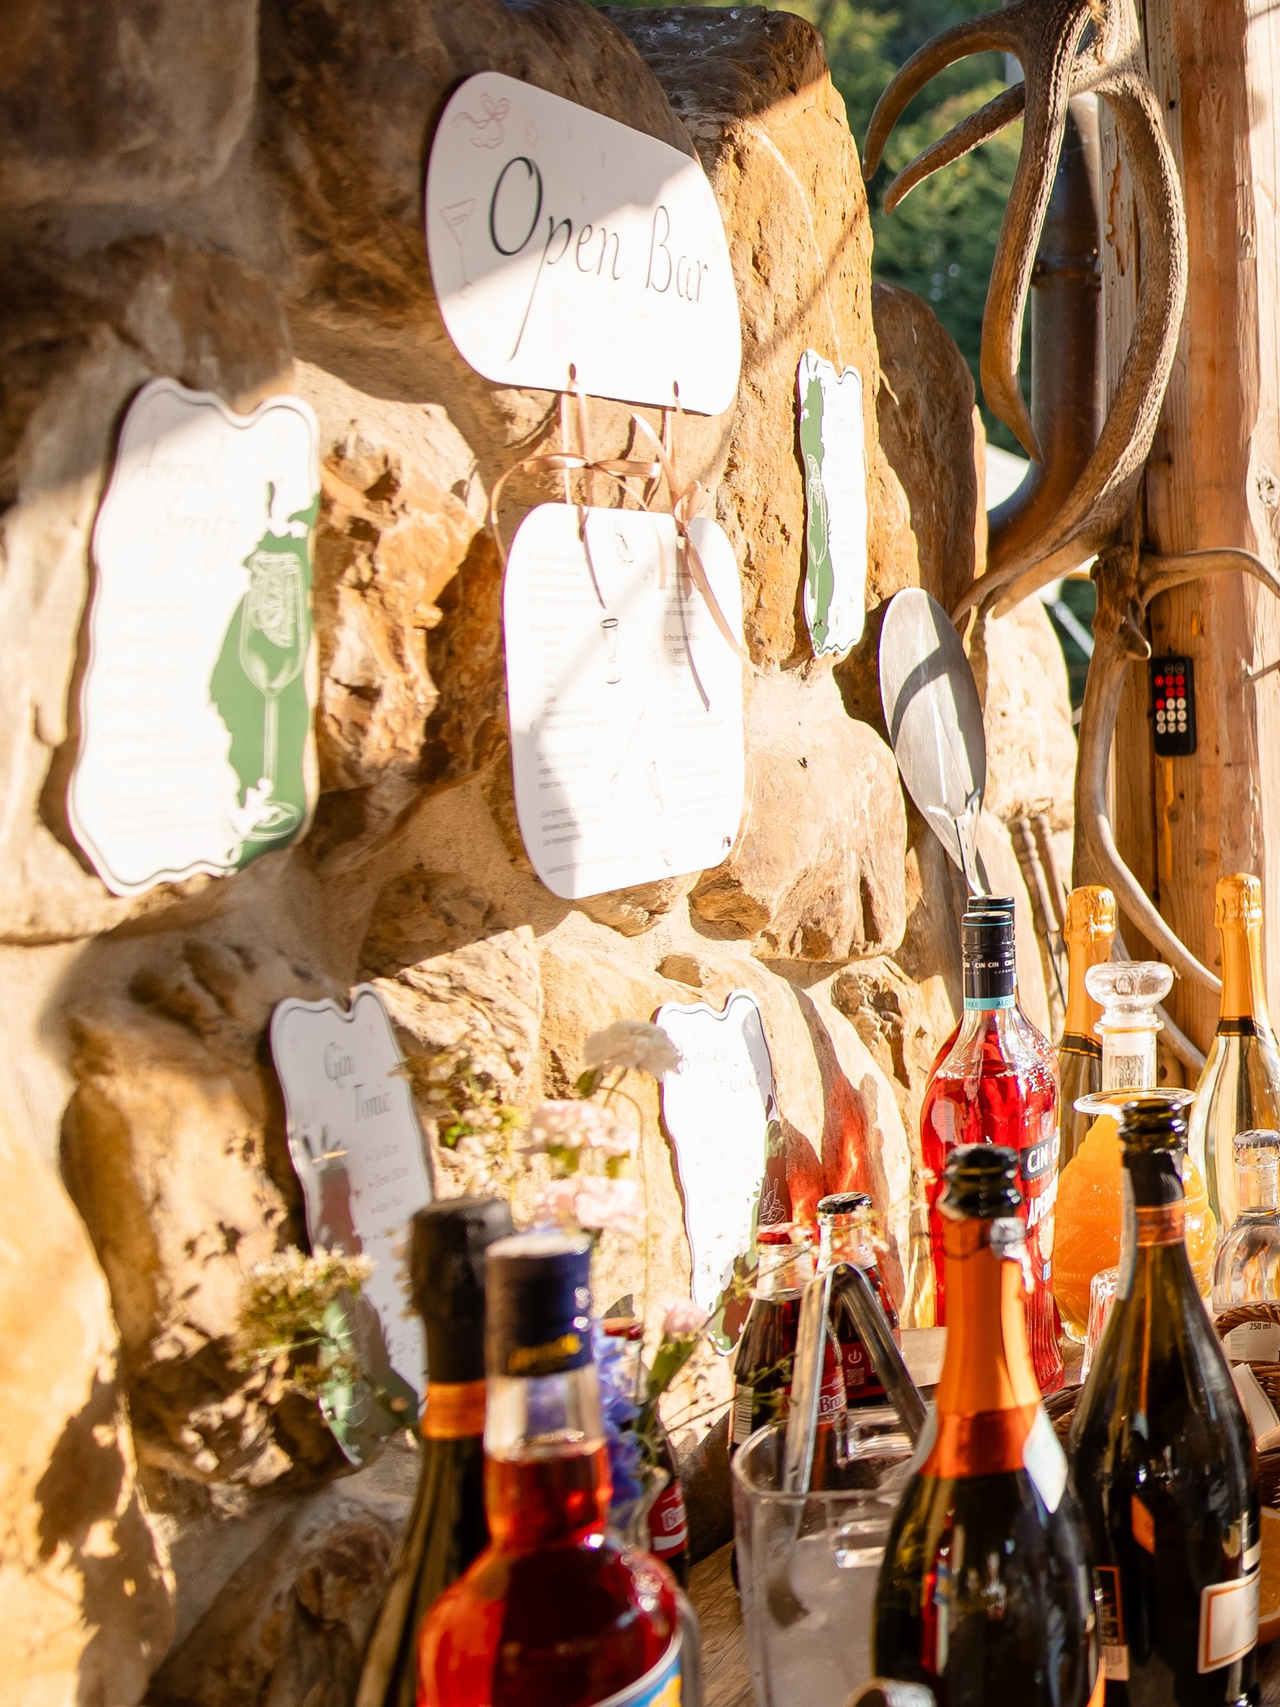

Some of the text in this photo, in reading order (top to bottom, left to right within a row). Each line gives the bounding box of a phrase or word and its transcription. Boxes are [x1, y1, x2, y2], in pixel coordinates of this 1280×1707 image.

[489, 155, 709, 363] Open Bar
[1026, 1143, 1049, 1174] CIN
[1249, 1321, 1272, 1331] 250 ml
